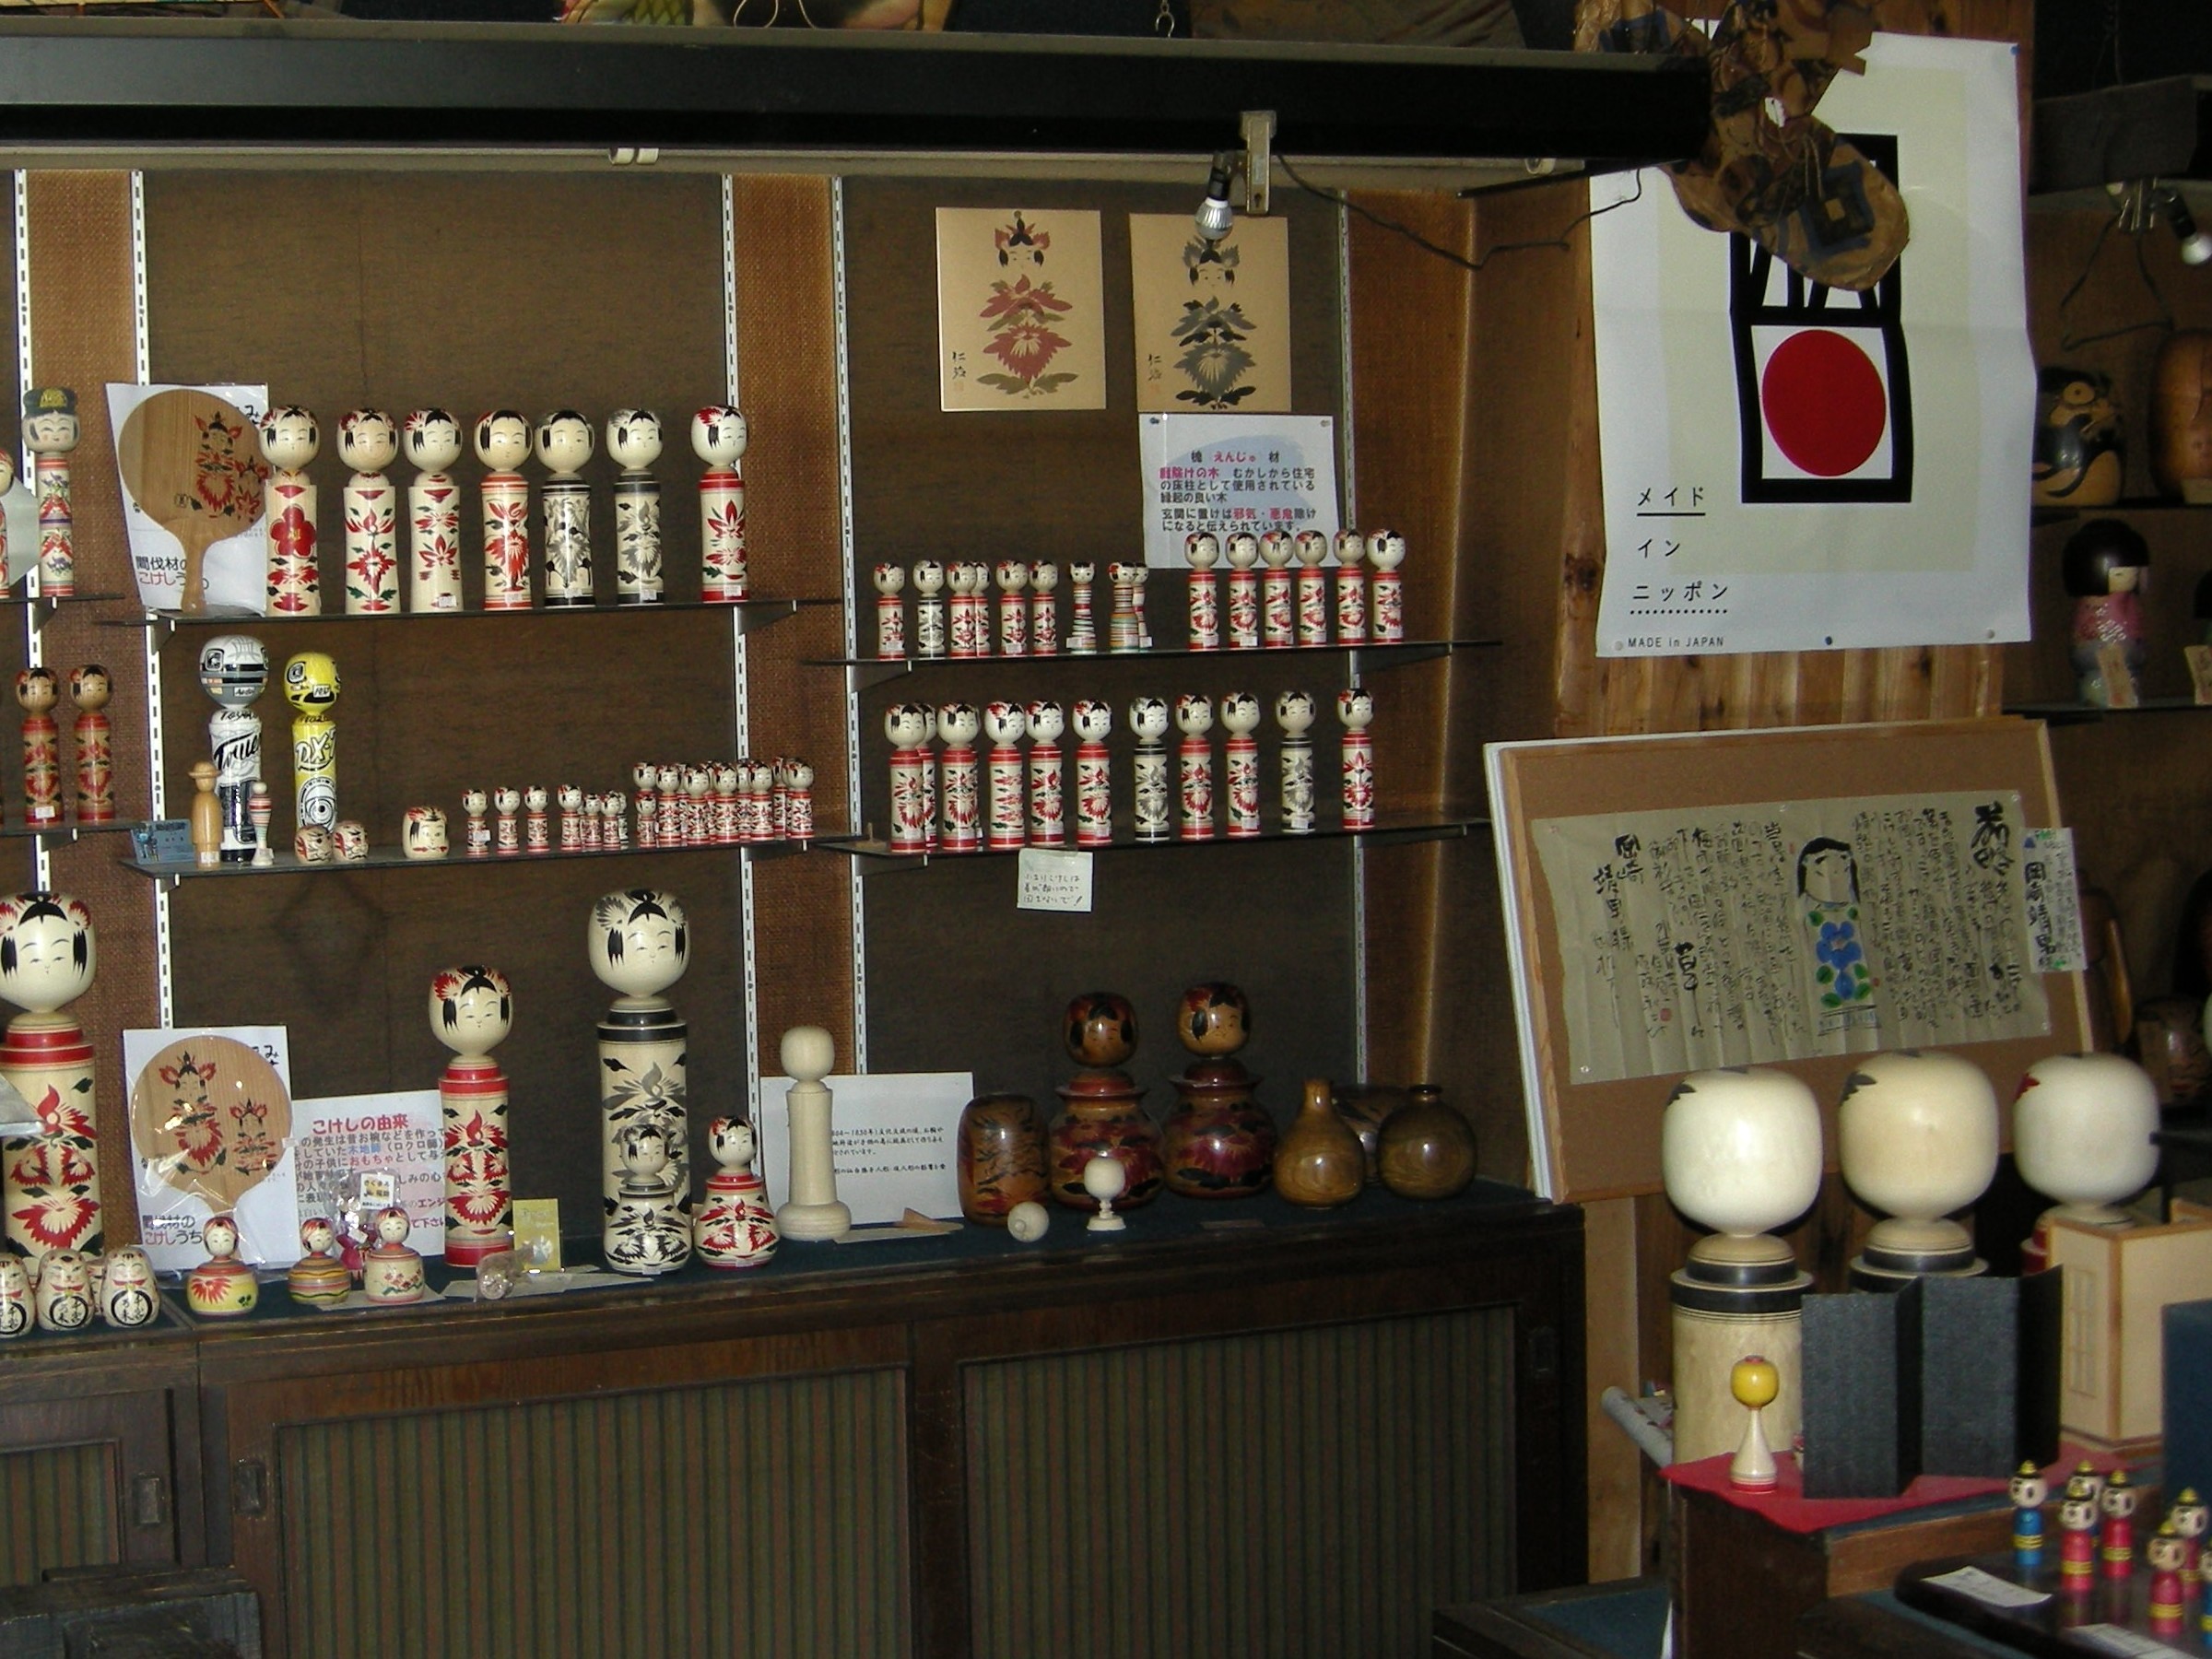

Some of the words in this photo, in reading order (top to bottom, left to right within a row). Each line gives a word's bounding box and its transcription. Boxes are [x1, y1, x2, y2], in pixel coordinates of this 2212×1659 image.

[1213, 451, 1257, 463] えんじゅ
[1268, 450, 1280, 463] 材
[1232, 466, 1315, 479] むかしから住宅
[1160, 479, 1315, 492] の床柱として使用されている
[1160, 491, 1228, 504] 縁起の良い木
[1637, 487, 1704, 507] メイド
[1637, 537, 1681, 559] イン
[1632, 580, 1728, 602] ニッポン
[1628, 637, 1662, 648] MADE
[1686, 636, 1724, 647] JAPAN
[312, 1113, 409, 1135] こけしの由来
